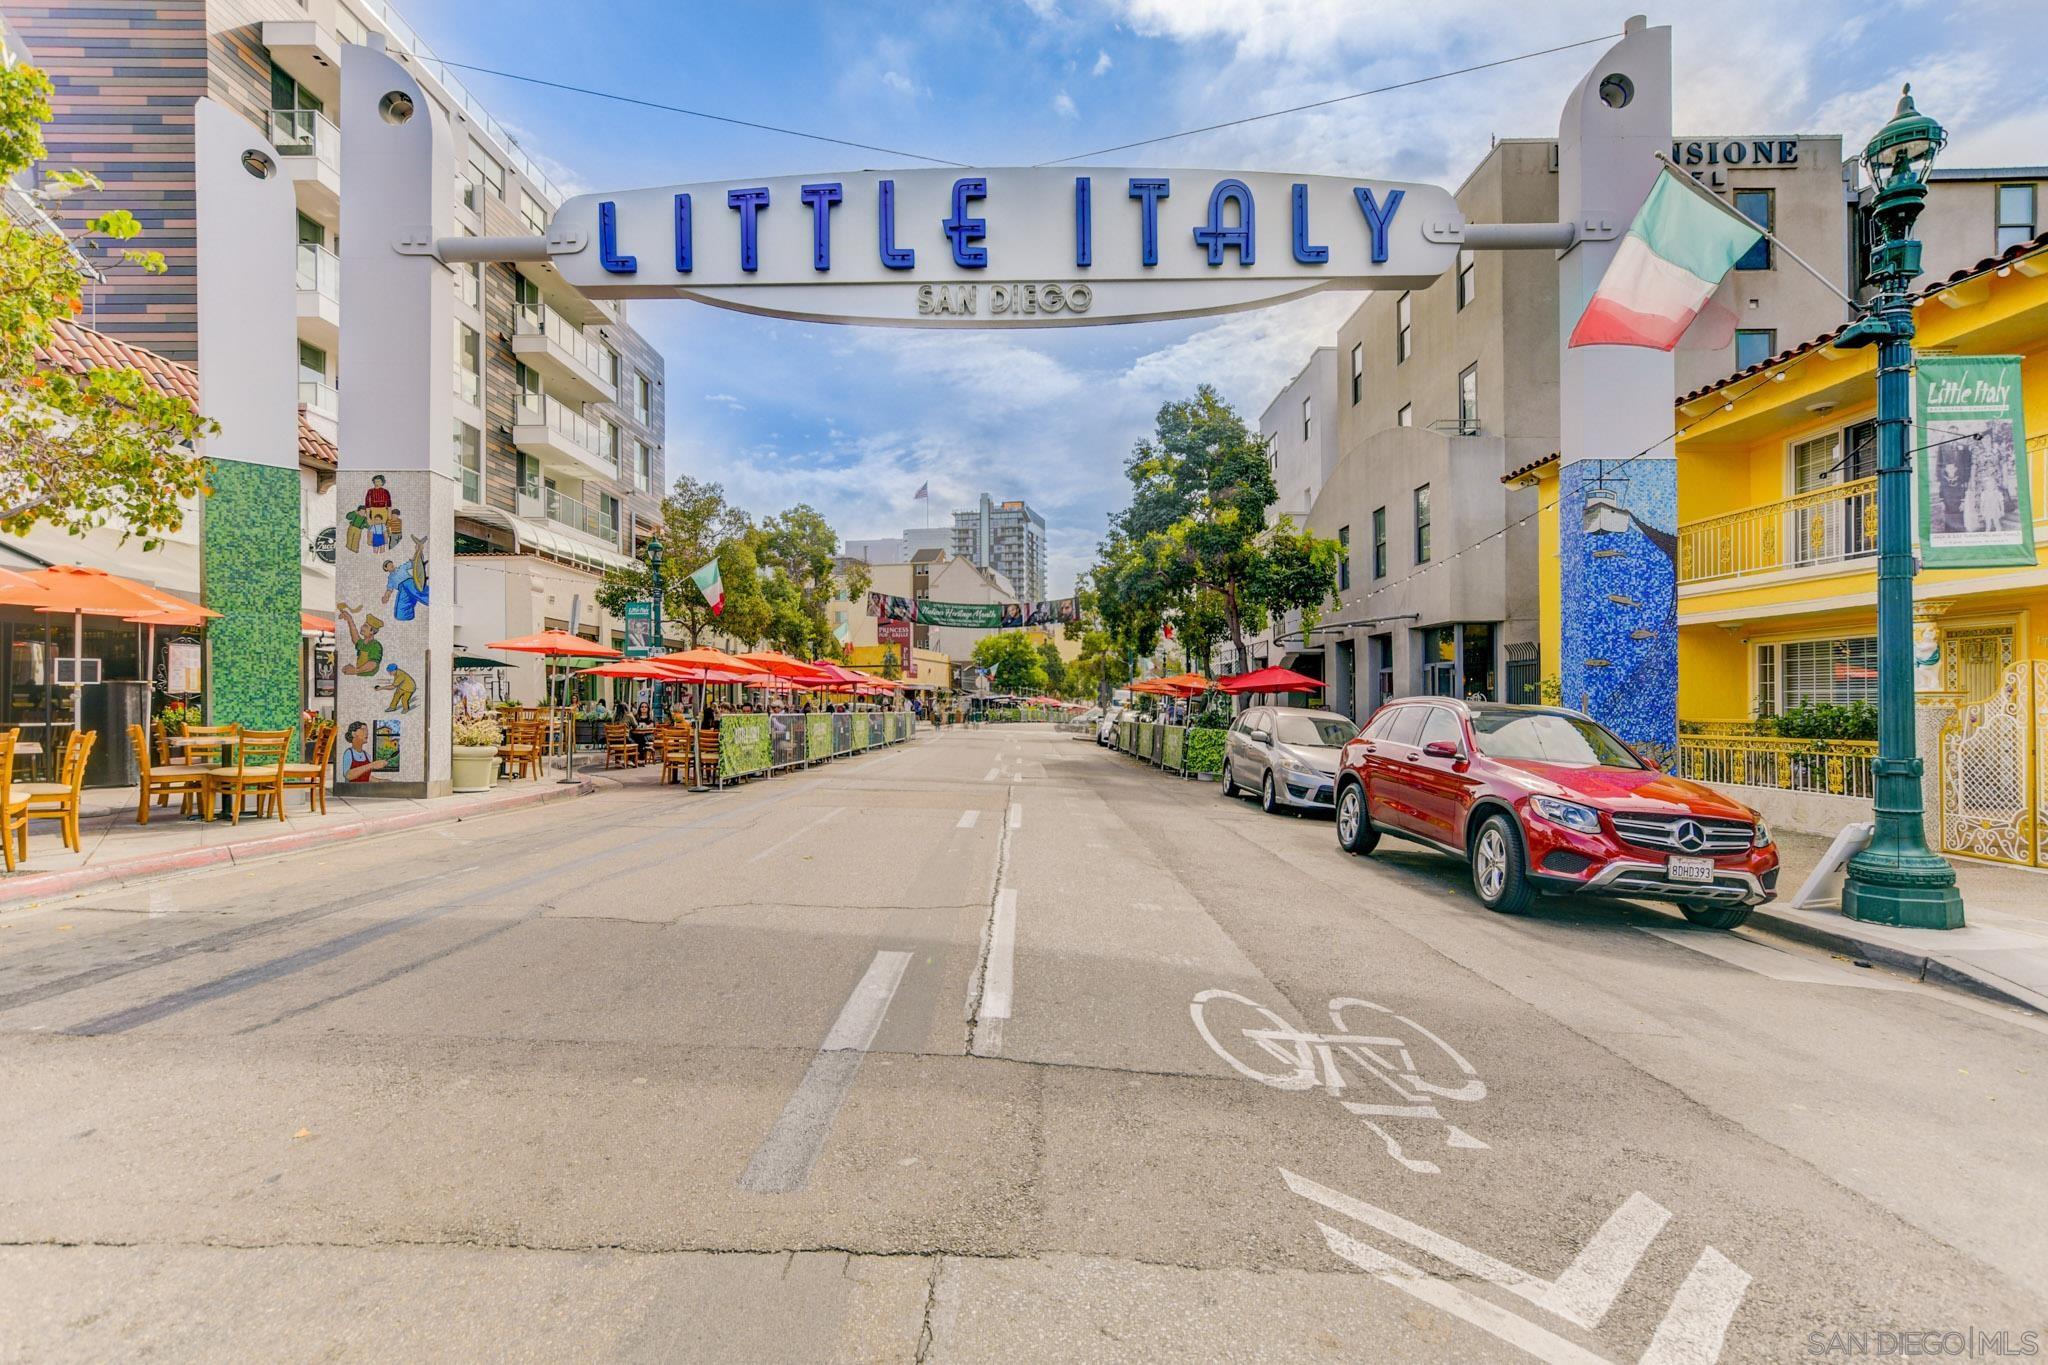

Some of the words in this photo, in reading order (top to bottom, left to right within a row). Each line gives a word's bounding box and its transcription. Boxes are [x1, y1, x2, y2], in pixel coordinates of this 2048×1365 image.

[599, 177, 988, 274] LITTLE
[1075, 177, 1406, 267] ITALY
[918, 284, 977, 315] SAN
[990, 283, 1093, 314] DIEGO
[1928, 369, 1972, 404] Little
[1974, 367, 2011, 418] Italy
[973, 609, 996, 620] Month
[1672, 865, 1711, 879] 8DHD393
